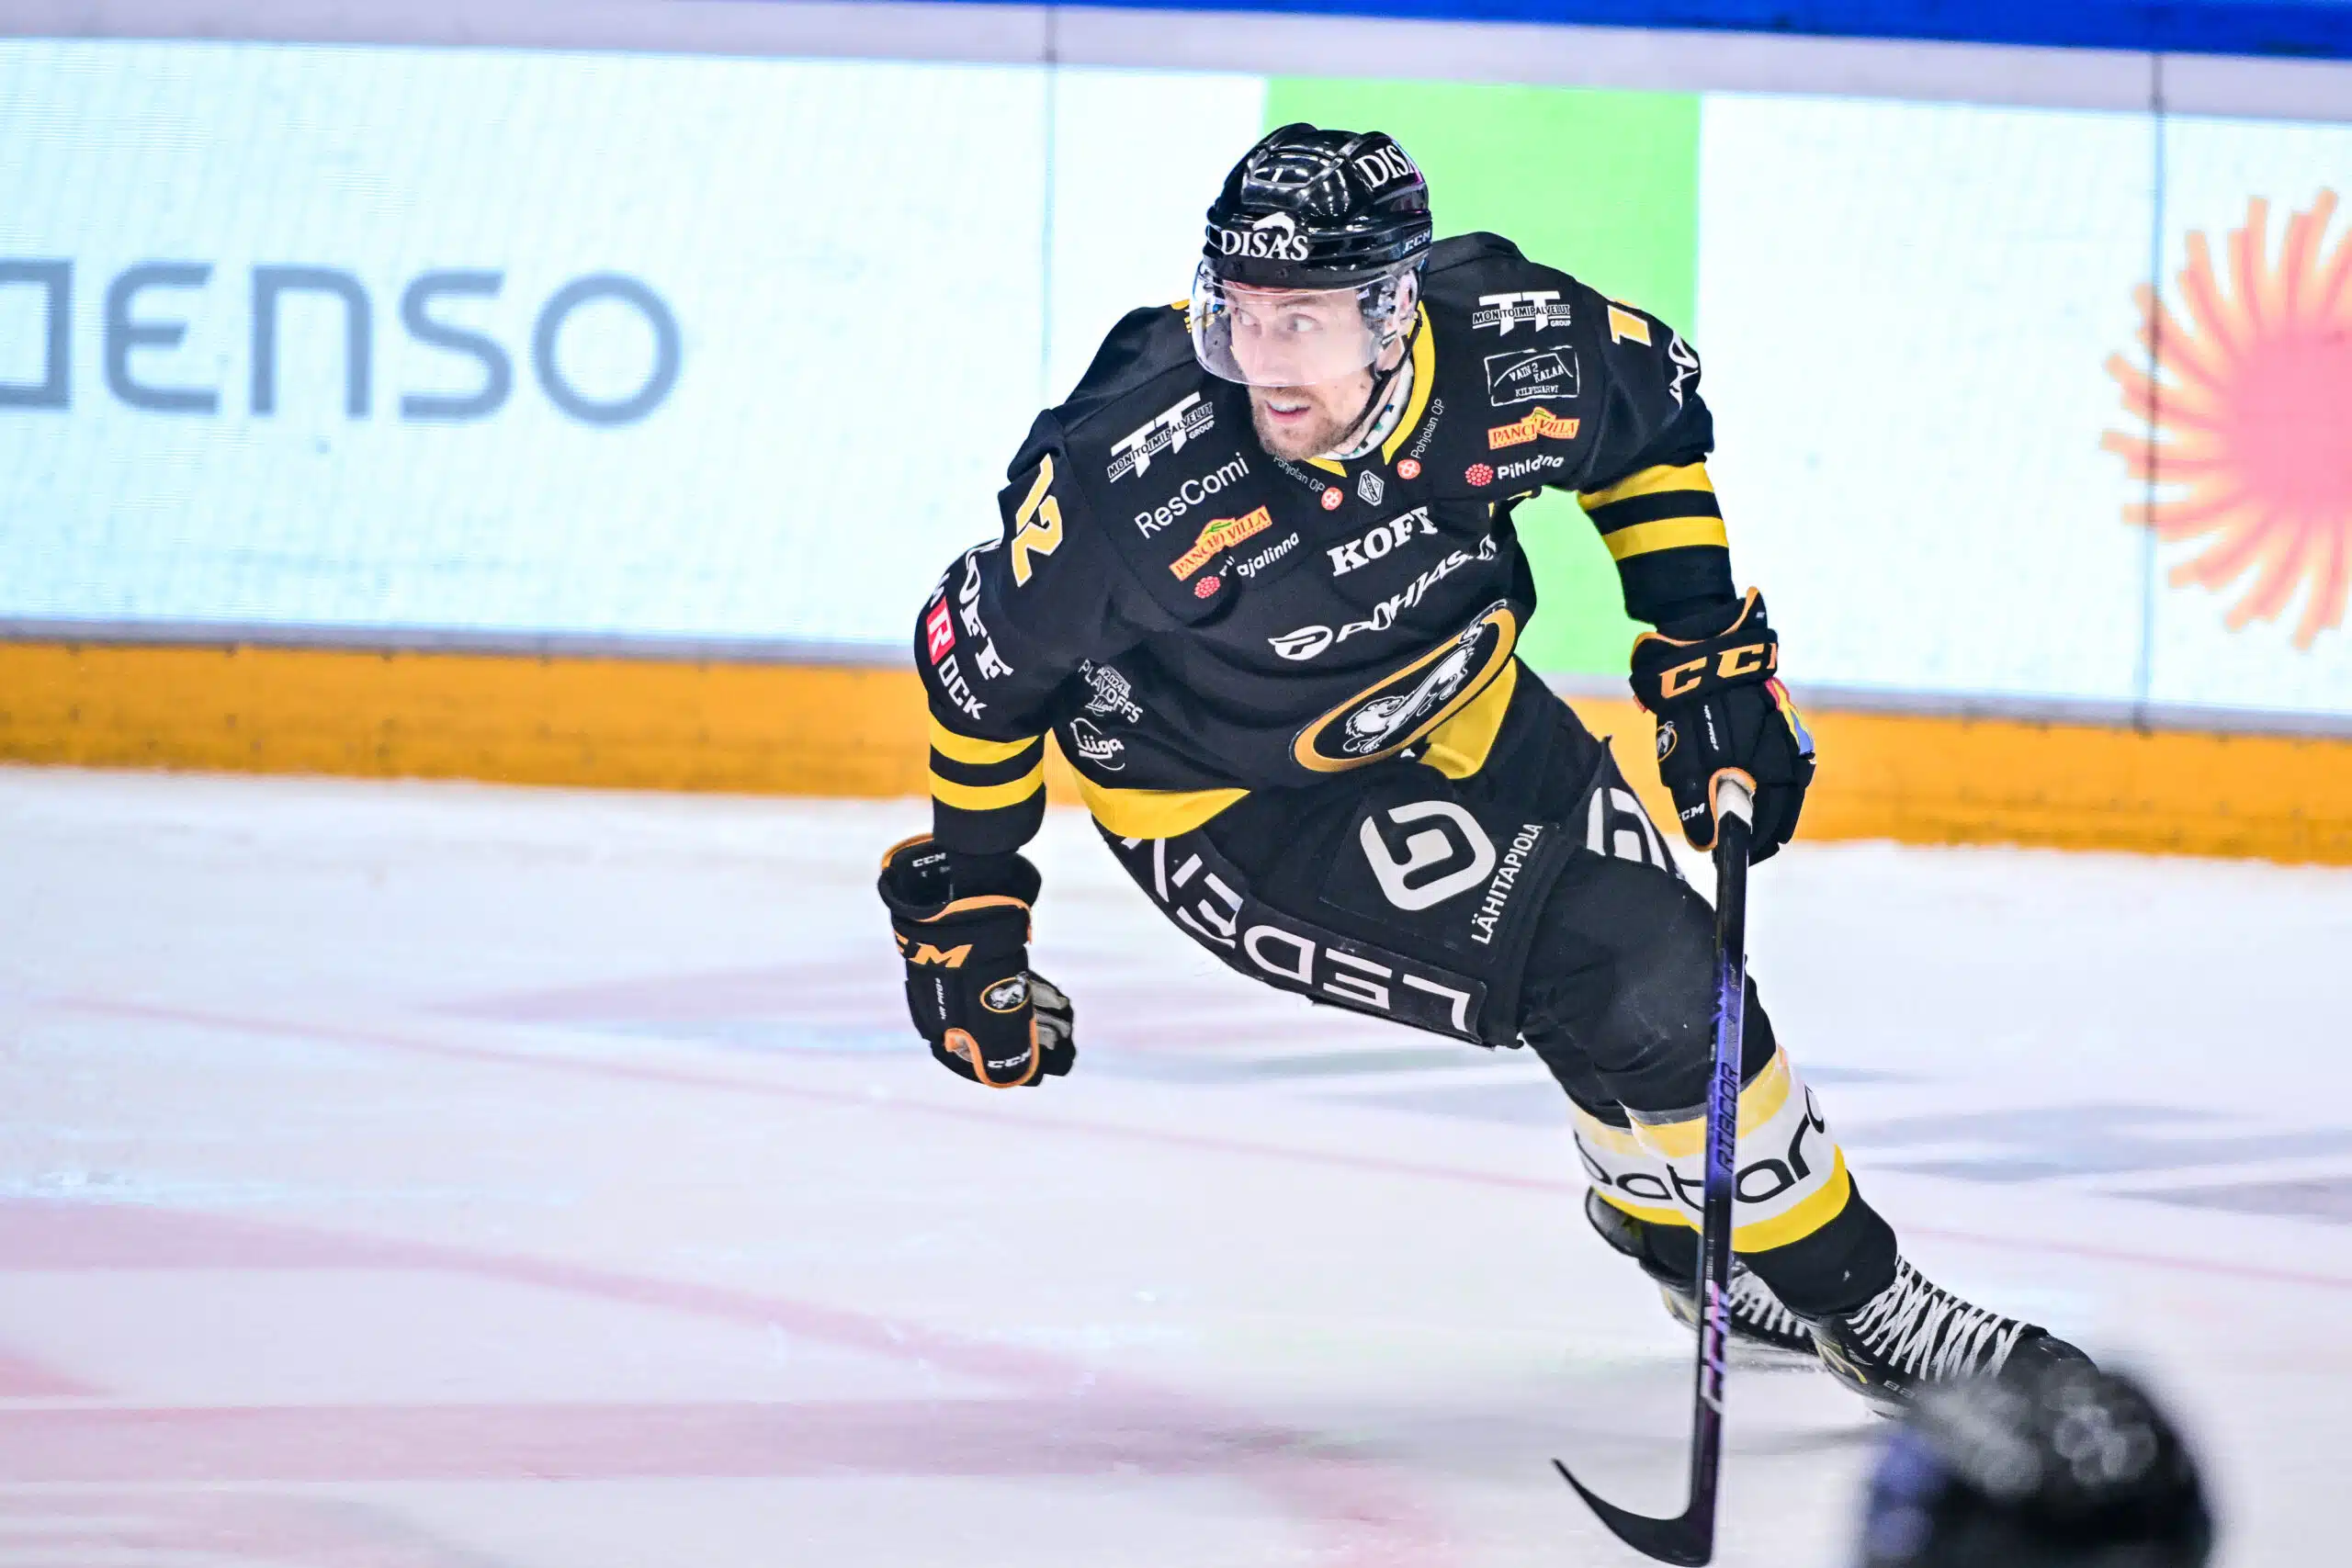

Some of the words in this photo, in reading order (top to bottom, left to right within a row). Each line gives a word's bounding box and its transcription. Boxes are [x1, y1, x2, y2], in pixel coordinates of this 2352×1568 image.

[1220, 228, 1308, 261] DISAS
[1473, 305, 1570, 324] MONITOIMIPALVELUT
[1607, 297, 1652, 347] 1
[1510, 365, 1532, 382] VAIN
[1532, 363, 1539, 373] 2
[1533, 367, 1565, 384] KALAA
[1107, 401, 1213, 479] MONITOIMIPALVELUT
[1189, 420, 1215, 440] GROUP
[1410, 418, 1438, 459] Pohjolan
[1433, 398, 1445, 418] OP
[1135, 452, 1250, 539] ResComi
[1309, 477, 1326, 493] OP
[1012, 453, 1063, 587] 12
[1174, 533, 1226, 574] PANCHO
[1227, 510, 1269, 541] VILLA
[1078, 659, 1143, 723] PLAYOFFS
[1102, 670, 1124, 692] 2024
[1069, 717, 1125, 761] Liiga
[1679, 803, 1705, 821] CM
[912, 852, 946, 867] CCM
[1471, 823, 1544, 944] LÄHITAPIOLA
[1715, 1062, 1738, 1172] RIBCOR
